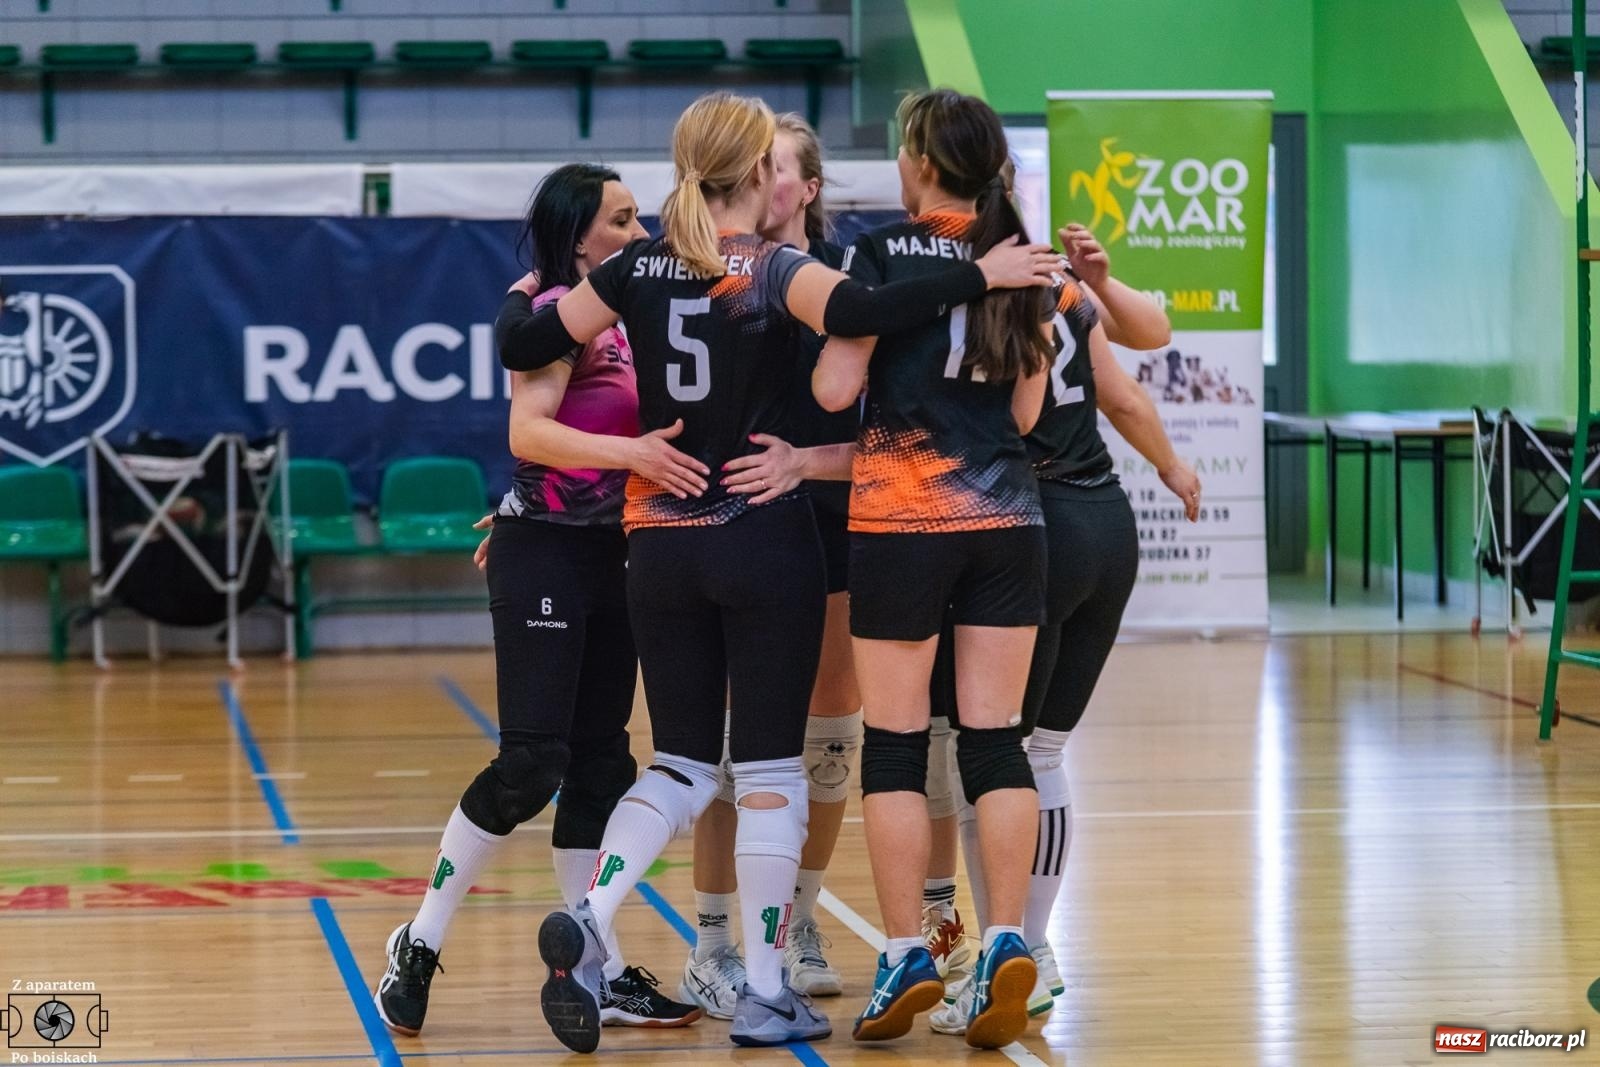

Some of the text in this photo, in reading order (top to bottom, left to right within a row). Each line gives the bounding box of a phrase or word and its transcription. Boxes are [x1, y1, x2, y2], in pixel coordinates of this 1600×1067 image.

[1135, 159, 1248, 197] ZOO
[1126, 197, 1246, 233] MAR
[1127, 234, 1246, 250] sklep zoologiczny
[243, 322, 512, 403] RACI
[666, 297, 711, 402] 5
[526, 619, 568, 629] DAMONS
[541, 597, 552, 615] 6
